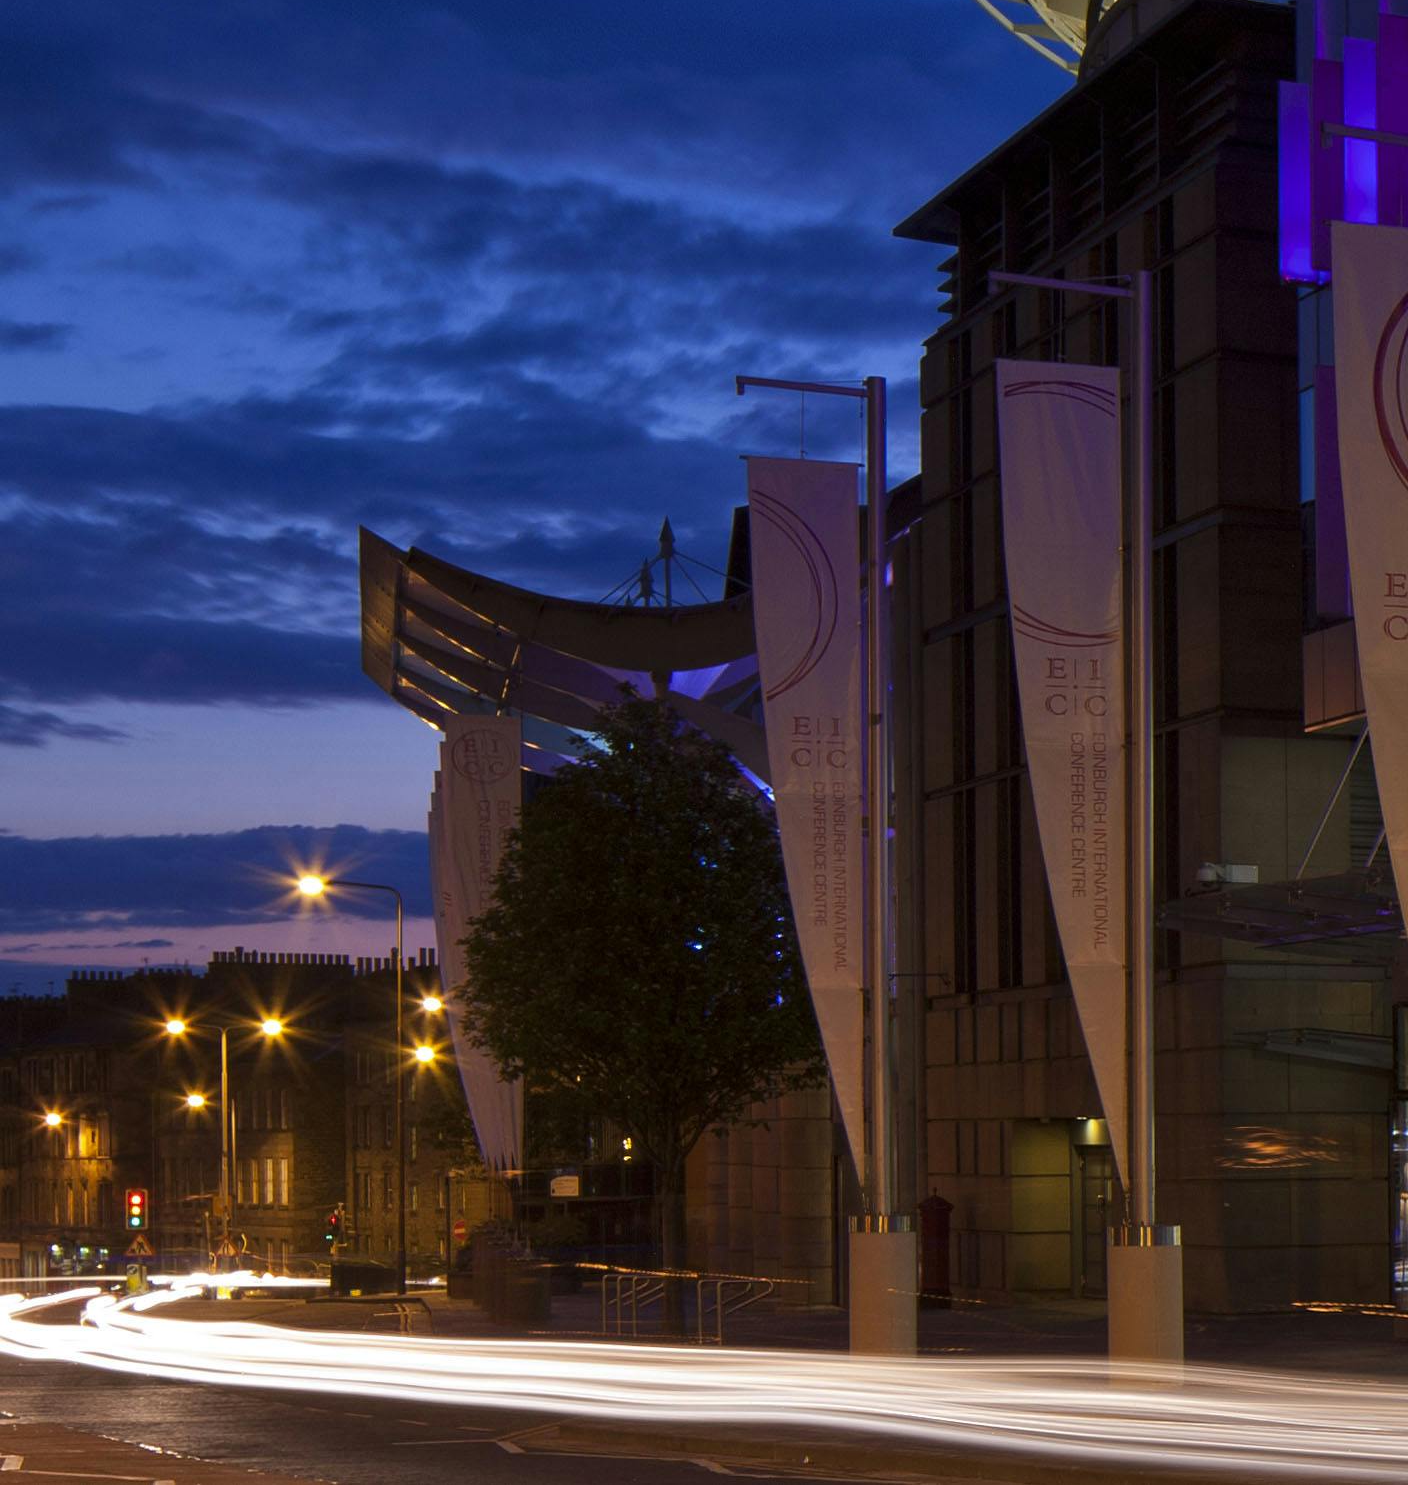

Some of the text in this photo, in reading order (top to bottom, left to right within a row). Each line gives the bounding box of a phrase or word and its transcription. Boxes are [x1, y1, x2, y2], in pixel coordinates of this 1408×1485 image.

[813, 781, 827, 926] CONFERENCE CENTRE
[832, 782, 848, 972] EDINBURGH INTERNATIONAL
[1071, 732, 1086, 898] CONFERENCE CENTRE
[1093, 732, 1109, 949] EDINBURGH INTERNATIONAL
